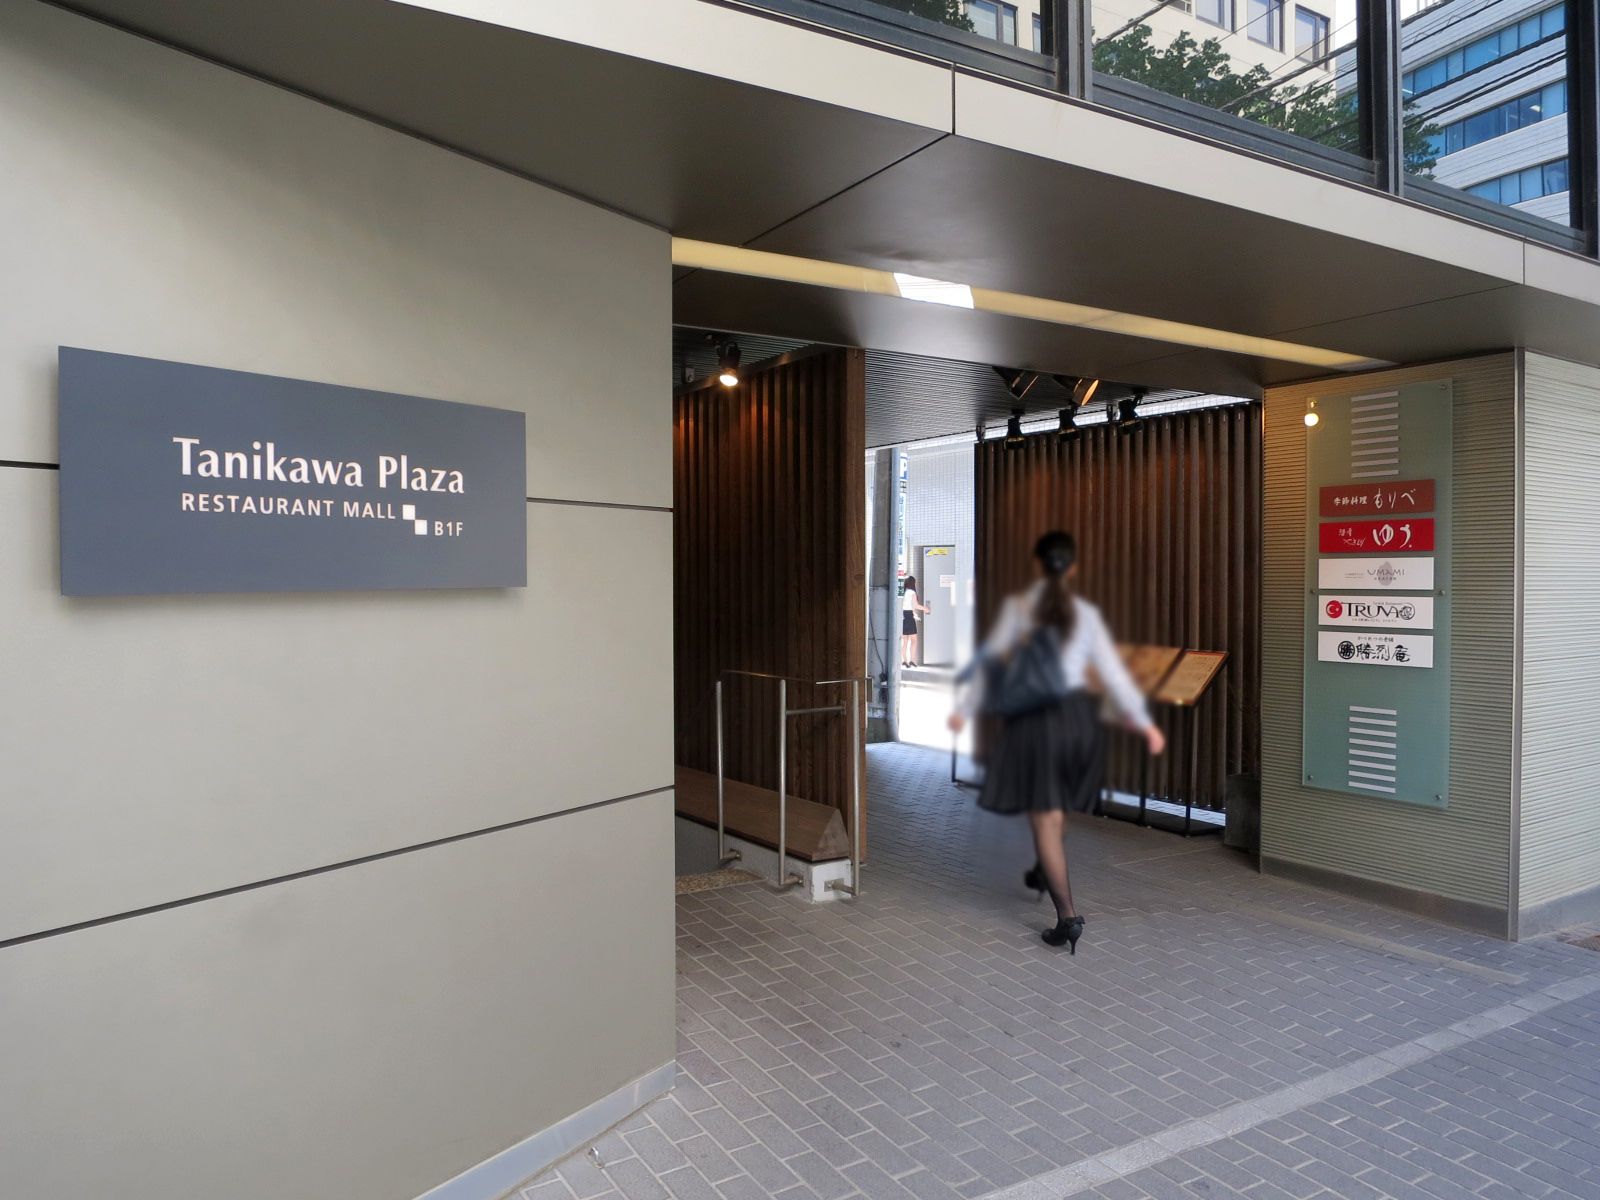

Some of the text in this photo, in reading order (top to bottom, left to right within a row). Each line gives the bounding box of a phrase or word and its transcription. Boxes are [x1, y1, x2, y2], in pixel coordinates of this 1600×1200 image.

[172, 436, 465, 494] Tanikawa Plaza
[181, 492, 464, 537] RESTAURANT MALL B1F
